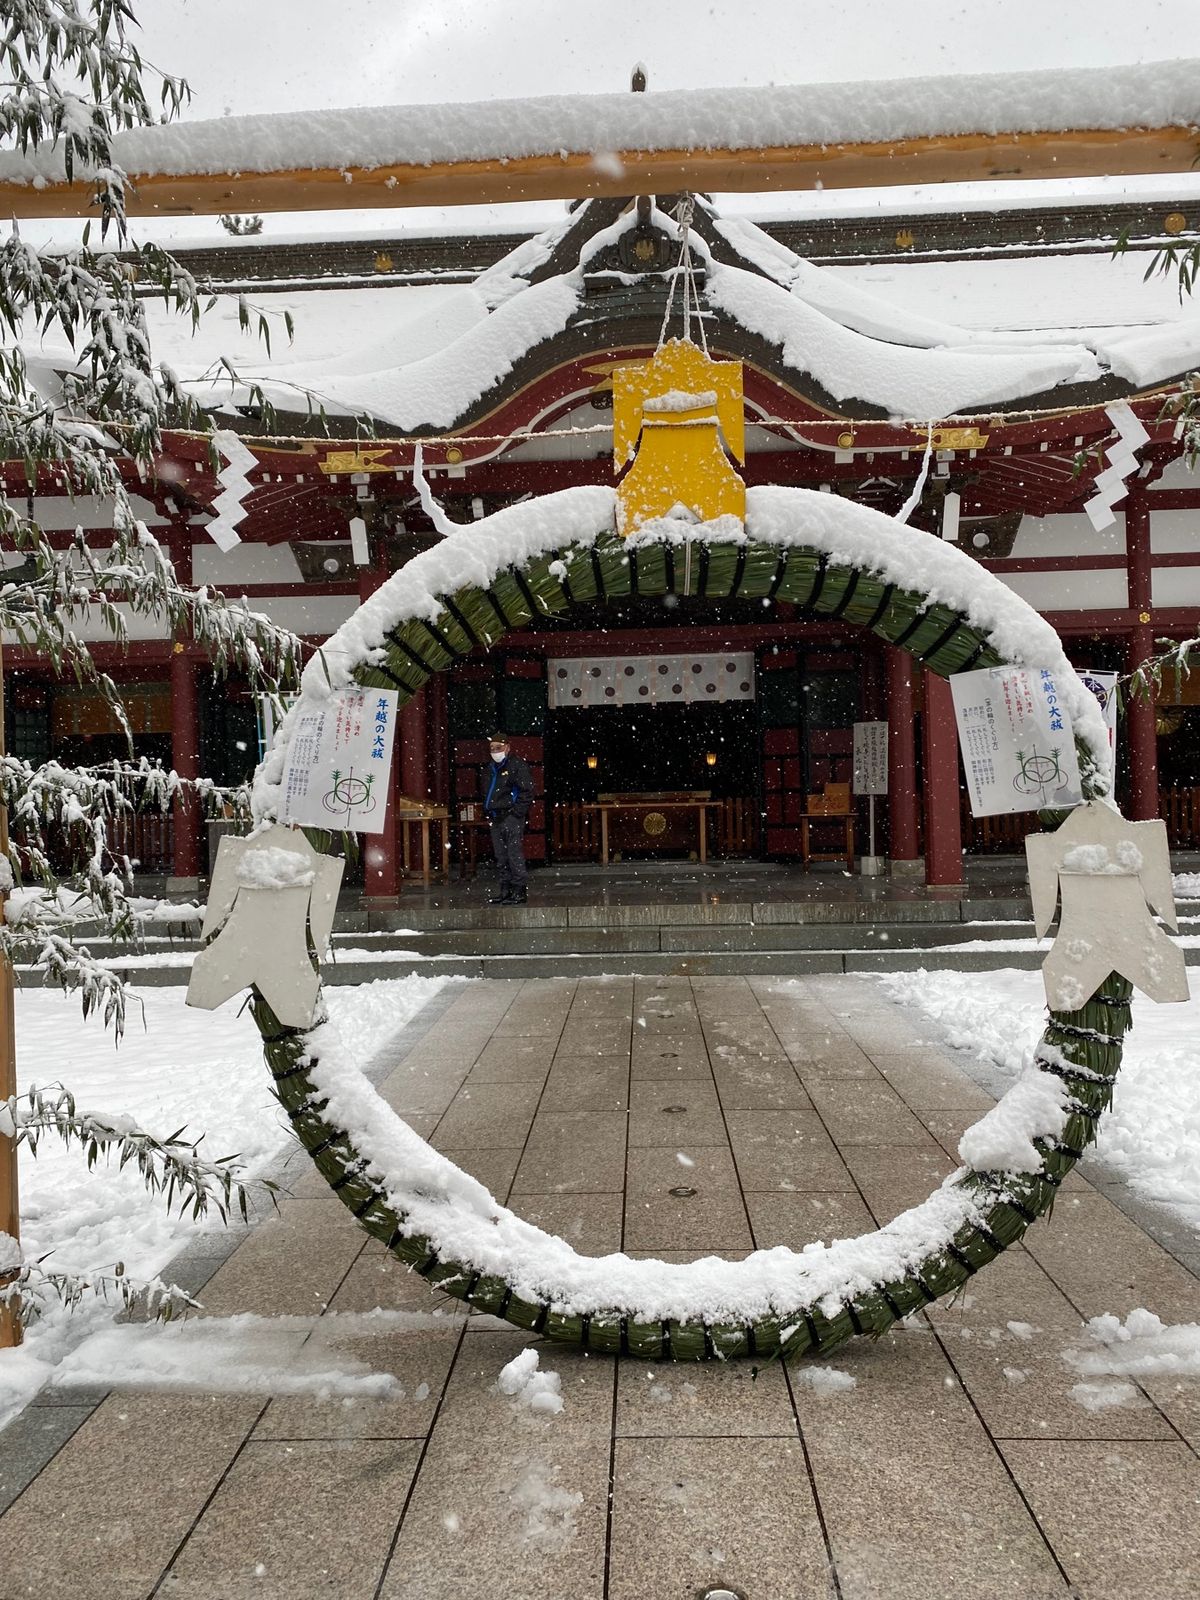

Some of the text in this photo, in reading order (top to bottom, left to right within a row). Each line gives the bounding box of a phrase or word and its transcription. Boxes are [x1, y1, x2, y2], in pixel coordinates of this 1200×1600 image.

[371, 698, 389, 759] 年越の大祓
[1040, 669, 1064, 731] 年越の大祓
